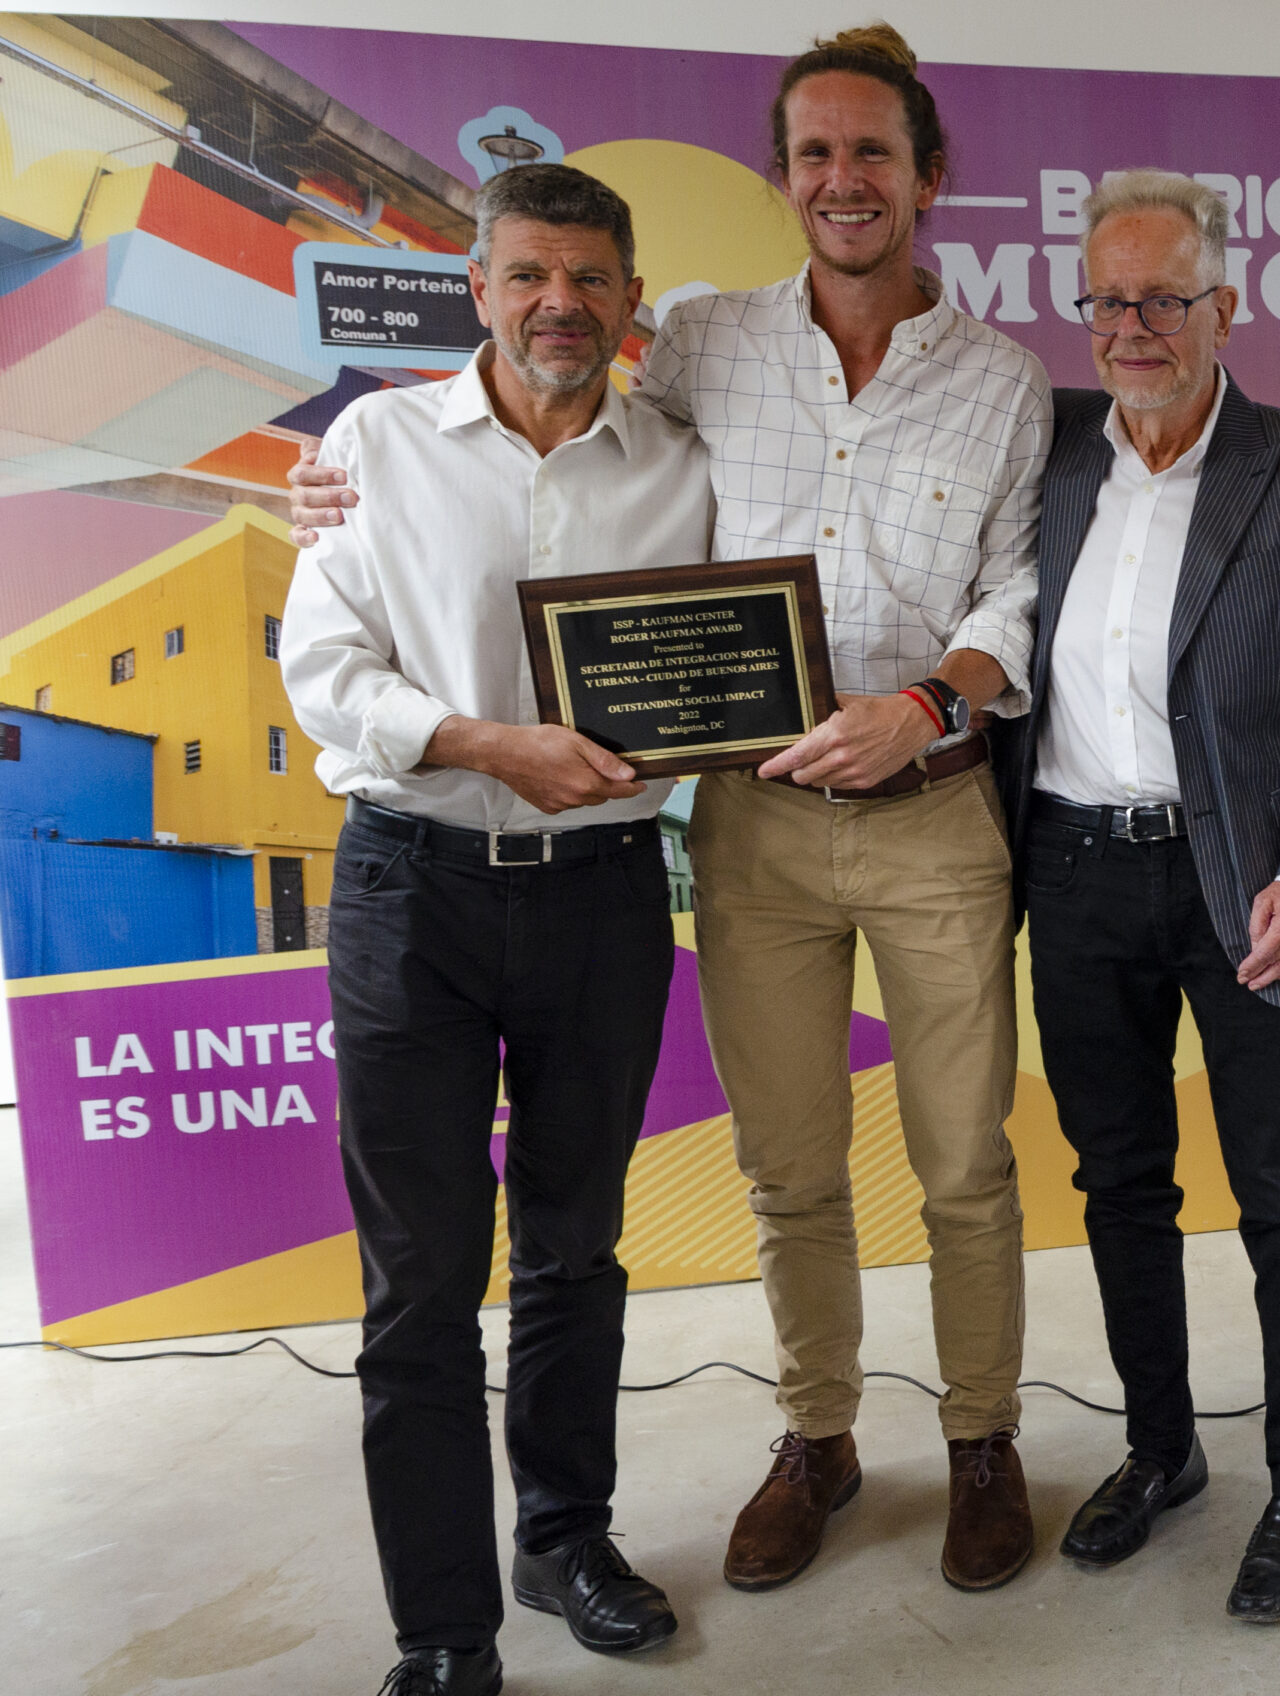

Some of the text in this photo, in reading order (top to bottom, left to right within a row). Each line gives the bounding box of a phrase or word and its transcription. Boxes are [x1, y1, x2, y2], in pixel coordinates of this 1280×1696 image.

[321, 270, 467, 295] Amor Porteño
[328, 306, 365, 323] 700
[382, 311, 419, 327] 800
[330, 328, 397, 341] Comuna 1
[613, 619, 635, 630] ISSP
[641, 614, 694, 627] KAUFMAN
[695, 610, 736, 621] CENTER
[610, 623, 743, 644] ROGER KAUFMAN AWARD
[653, 641, 705, 653] Presented to
[580, 647, 780, 675] SECRETARIA DE INTEGRACION SOCIAL
[585, 679, 594, 688] Y
[594, 675, 640, 688] URBANA
[646, 670, 687, 682] CIUDAD
[689, 668, 704, 677] DE
[705, 664, 748, 676] BUENOS
[748, 661, 780, 672] AIRES
[679, 684, 692, 693] for
[608, 690, 765, 713] OUTSTANDING SOCIAL IMPACT
[679, 711, 700, 720] 2022
[710, 720, 725, 729] DC
[75, 1033, 154, 1078] LA
[80, 1084, 317, 1141] ES UNA
